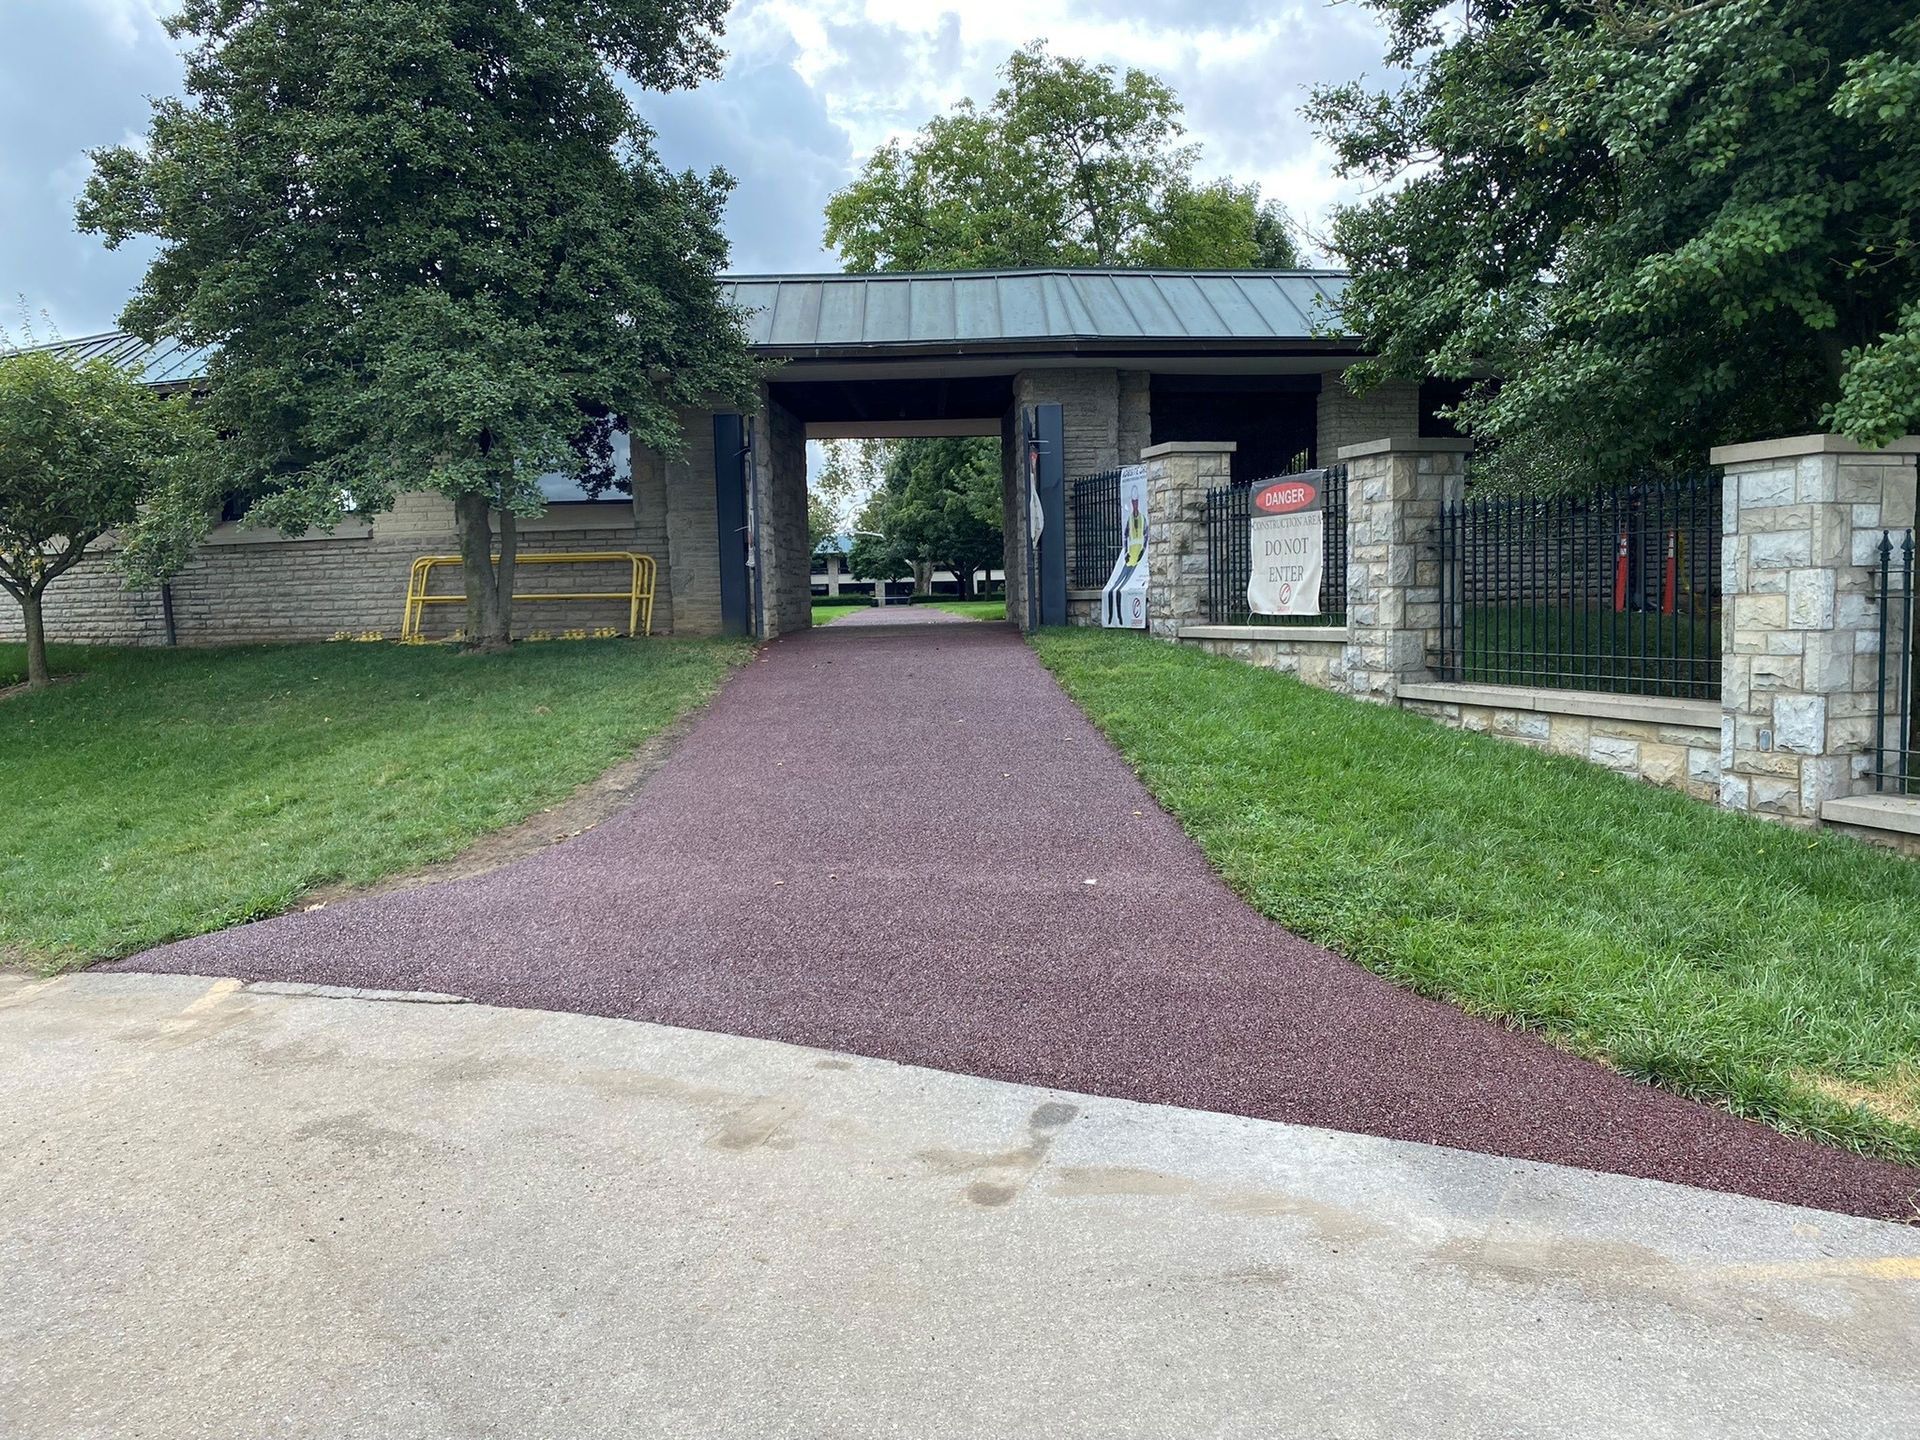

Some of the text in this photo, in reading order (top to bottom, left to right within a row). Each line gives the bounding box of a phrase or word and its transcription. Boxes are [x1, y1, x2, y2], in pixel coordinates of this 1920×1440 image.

[1265, 488, 1305, 507] DANGER
[1253, 514, 1322, 531] CONSTRUCTION AREA
[1265, 537, 1309, 556] DO NOT
[1268, 565, 1304, 583] ENTER
